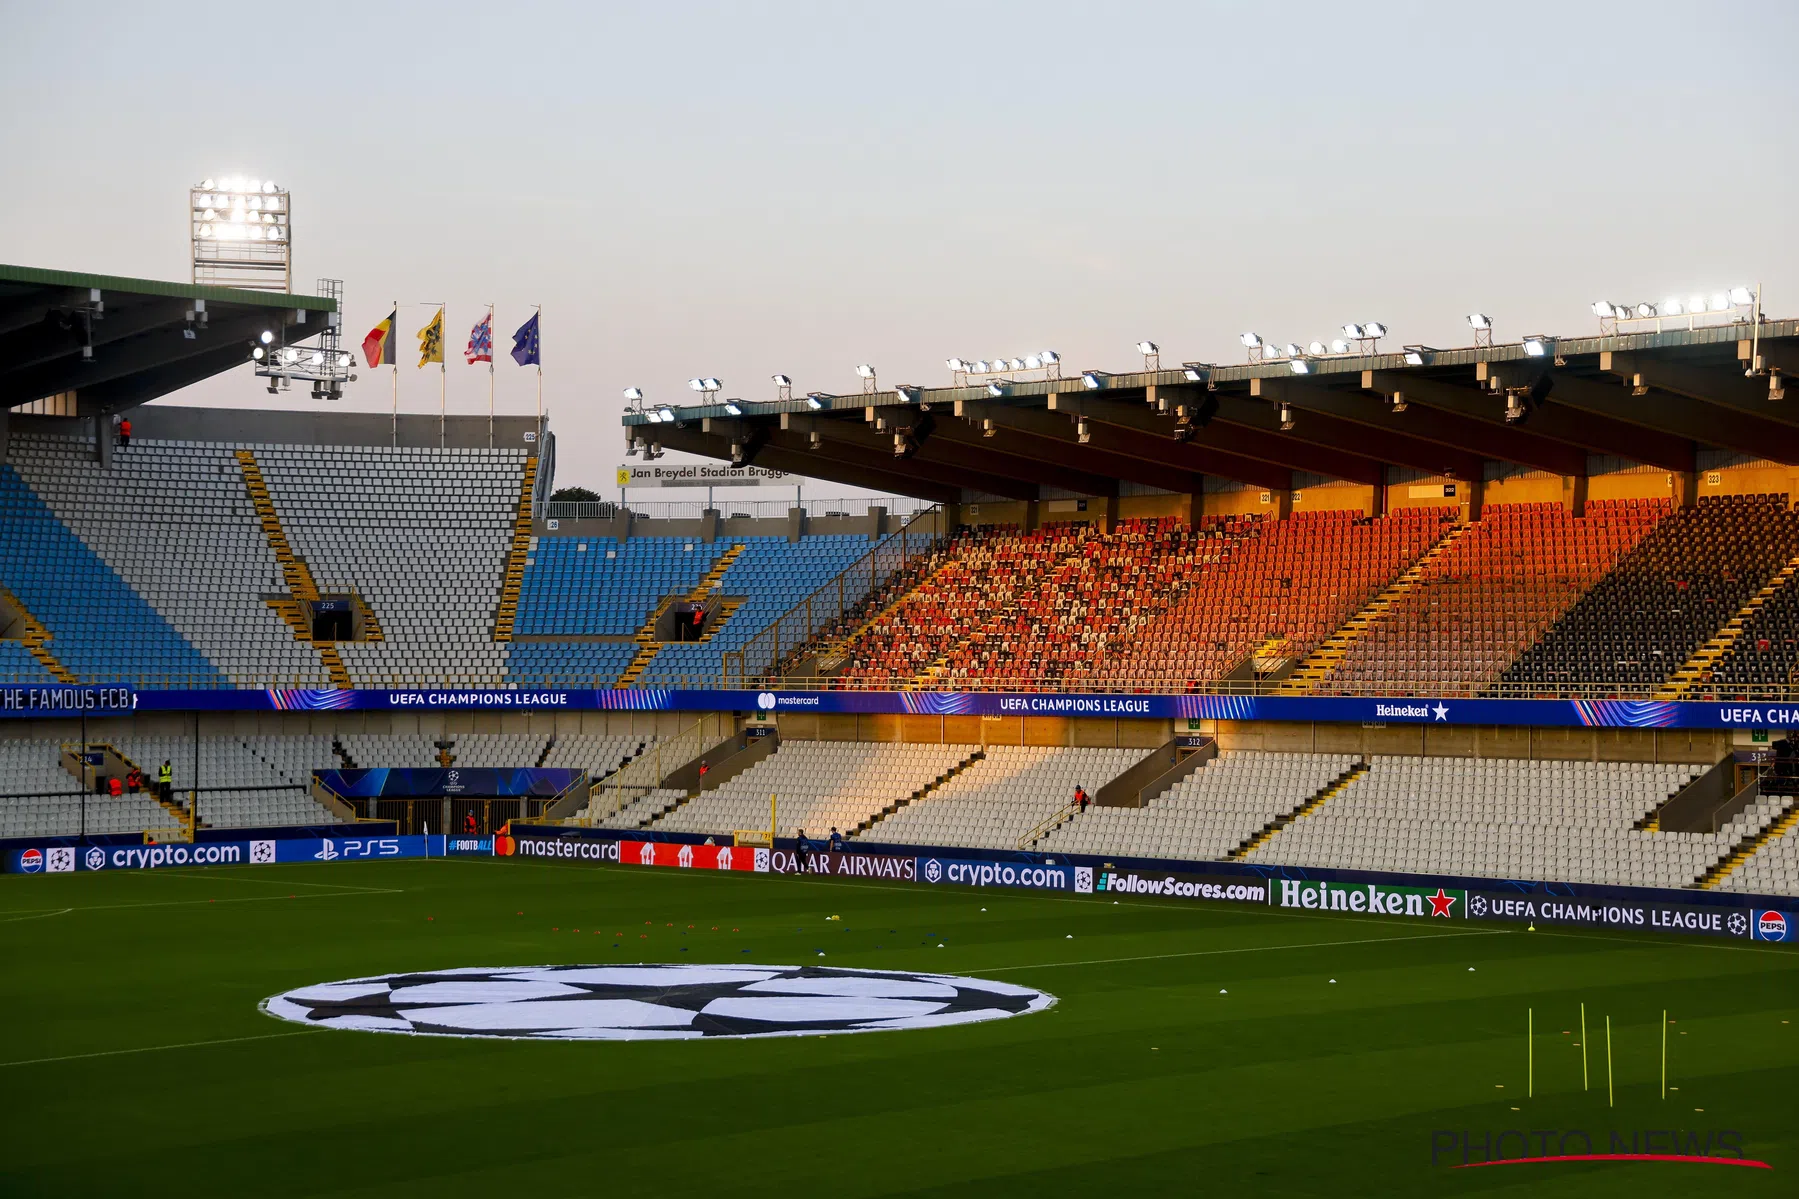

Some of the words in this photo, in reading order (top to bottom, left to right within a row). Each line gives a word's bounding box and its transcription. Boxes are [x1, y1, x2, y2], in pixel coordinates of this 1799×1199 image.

[631, 468, 651, 479] Jan
[654, 467, 697, 481] Breydel
[700, 467, 744, 478] Stadion
[1708, 475, 1720, 484] 323
[1261, 494, 1270, 502] 321
[30, 689, 95, 710] FAMOUS
[100, 688, 129, 709] FCB
[390, 694, 425, 704] UEFA
[428, 693, 512, 705] CHAMPIONS
[515, 693, 567, 705] LEAGUE
[778, 696, 819, 705] mastercard
[1000, 698, 1029, 710] UEFA
[1032, 698, 1101, 712] CHAMPIONS
[1103, 699, 1150, 713] LEAGUE
[1376, 704, 1428, 717] Heineken
[1720, 708, 1763, 723] UEFA
[1188, 738, 1200, 746] 312
[344, 839, 400, 856] PS5
[449, 839, 492, 851] #FOOTBALL
[520, 838, 618, 860] mastercard
[22, 857, 42, 866] PEPSI
[112, 844, 240, 869] crypto.com
[837, 855, 914, 879] AIRWAYS
[948, 861, 1065, 888] crypto.com
[1106, 873, 1265, 901] FollowScores.com
[1280, 879, 1425, 916] Heineken
[1492, 899, 1536, 917] UEFA
[1540, 902, 1644, 925] CHAMPIONS
[1652, 909, 1722, 931] LEAGUE
[1760, 922, 1785, 932] PEPSI
